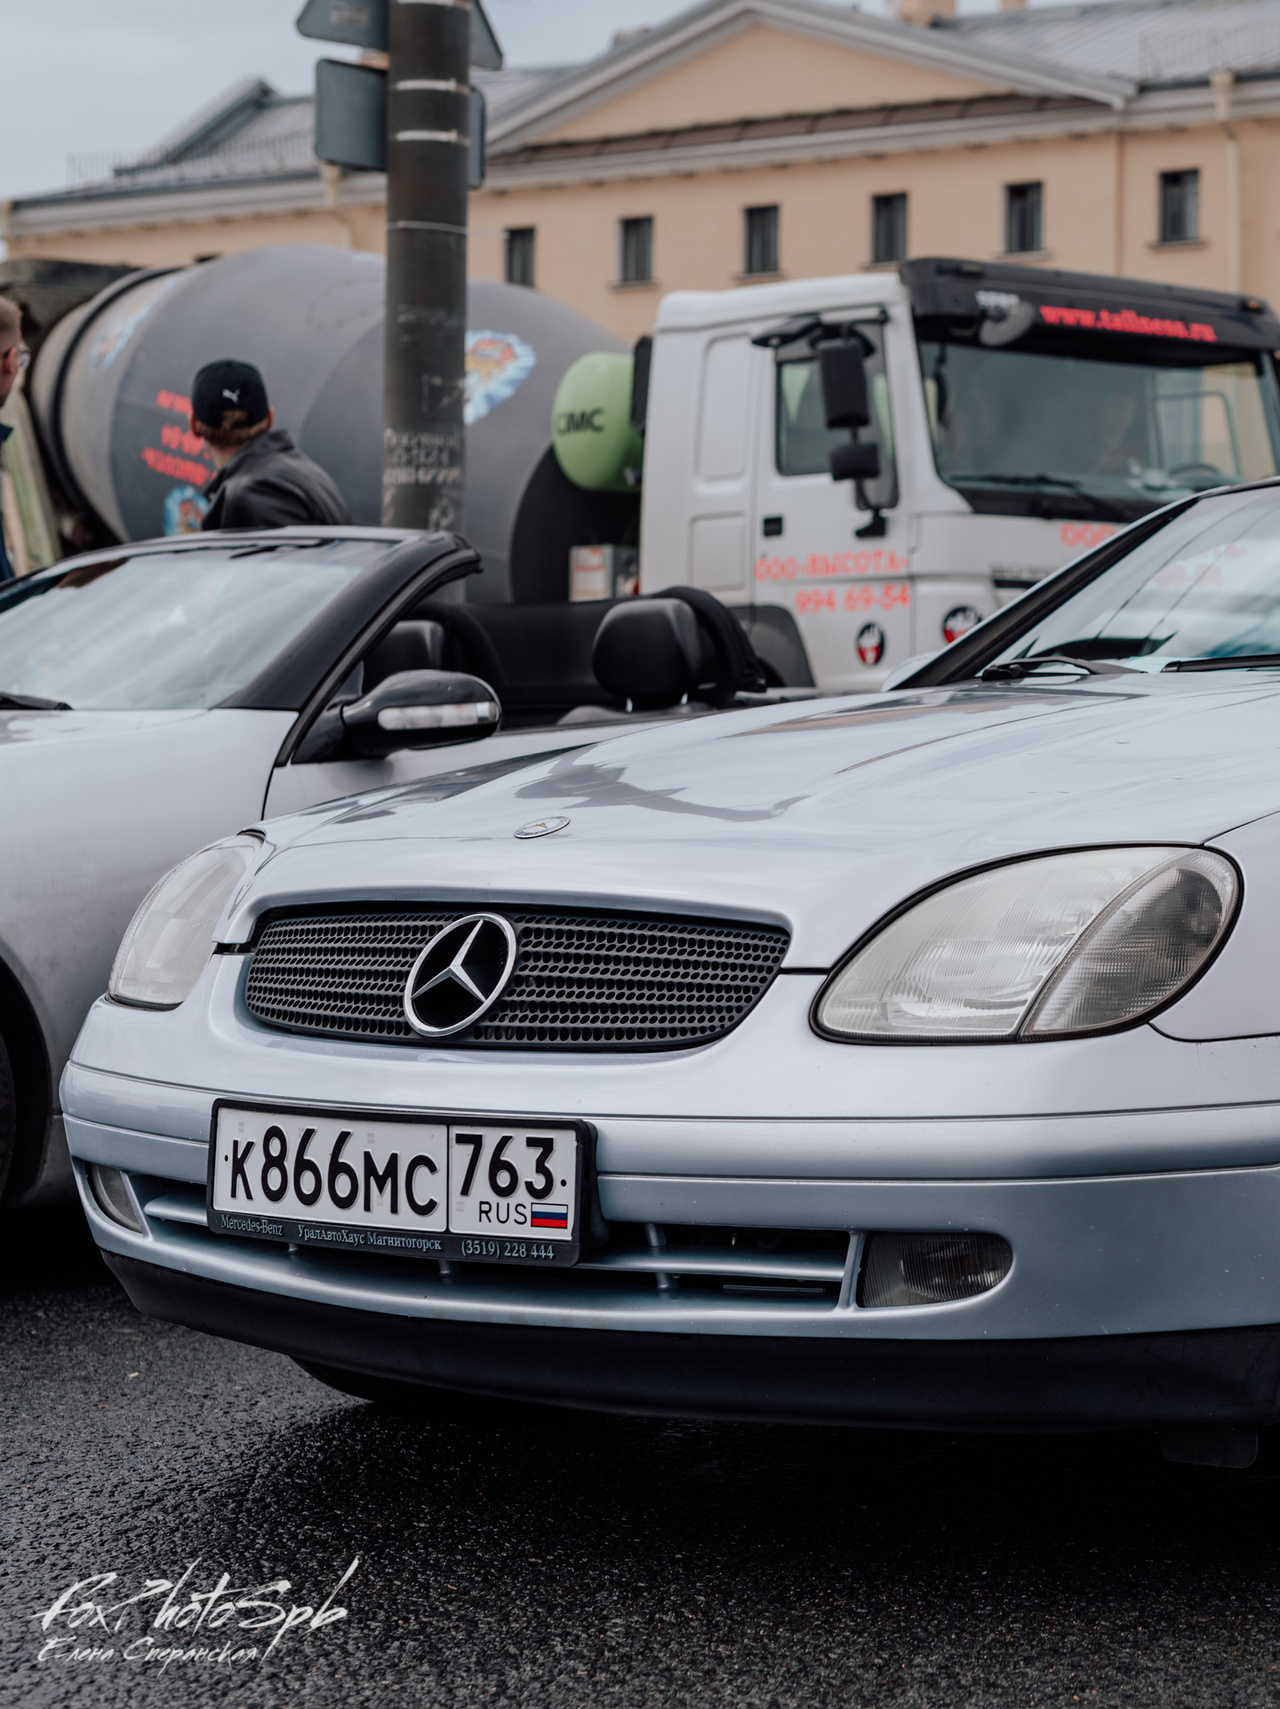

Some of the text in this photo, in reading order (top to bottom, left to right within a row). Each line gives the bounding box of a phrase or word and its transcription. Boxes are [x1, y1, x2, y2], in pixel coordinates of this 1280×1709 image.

[795, 582, 911, 616] 994 69-54
[455, 1133, 555, 1200] 763
[478, 1201, 528, 1225] RUS
[221, 1214, 555, 1260] Mercedes-Benz УралАвтоХаус Магнитогорск (3519) 228 444
